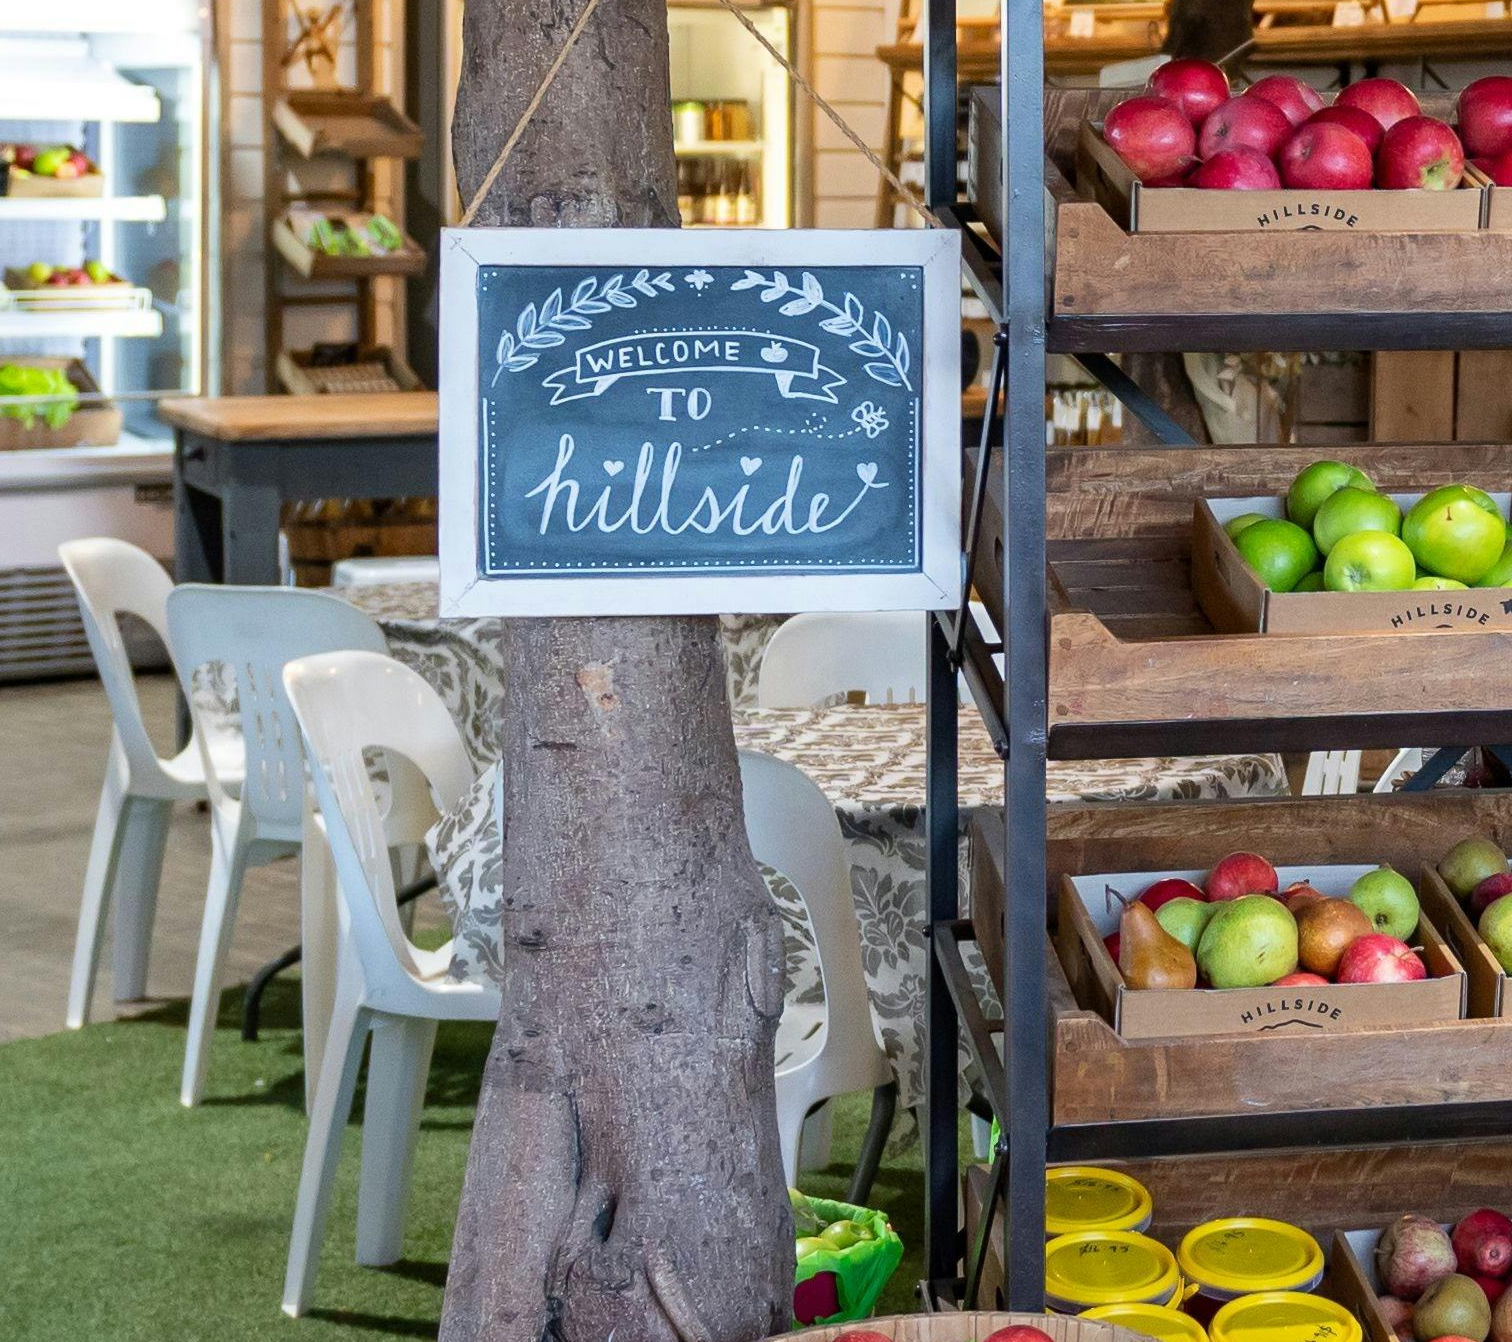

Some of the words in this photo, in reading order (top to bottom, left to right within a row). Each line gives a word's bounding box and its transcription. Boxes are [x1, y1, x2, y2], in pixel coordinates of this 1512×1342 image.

[1257, 202, 1358, 227] HILLSIDE
[586, 340, 740, 373] WELCOME
[646, 387, 712, 422] TO
[524, 433, 889, 536] hillside
[1390, 604, 1490, 629] HILLSIDE
[1240, 998, 1343, 1025] HILLSIDE
